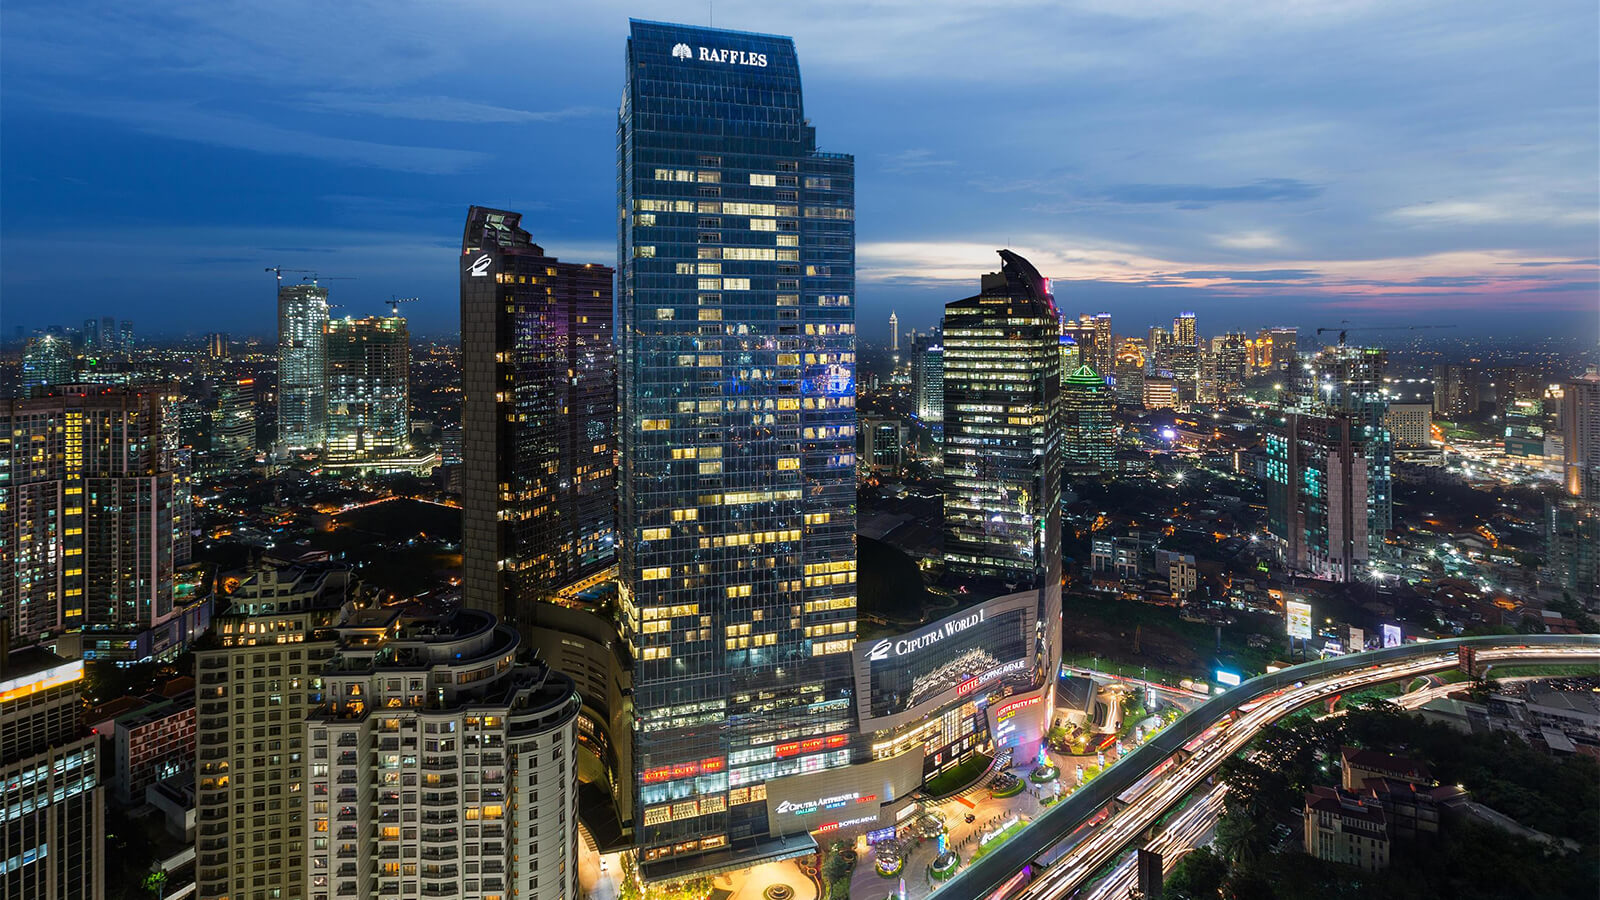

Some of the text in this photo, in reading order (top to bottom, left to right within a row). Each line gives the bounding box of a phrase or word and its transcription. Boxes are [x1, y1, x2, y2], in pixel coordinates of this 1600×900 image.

[699, 47, 767, 67] RAFFLES
[895, 629, 944, 655] CIPUTRA
[945, 614, 979, 636] WORLD
[958, 679, 979, 695] LOTTE
[1003, 660, 1025, 674] AVENUE
[1012, 700, 1028, 710] DUTY
[789, 800, 818, 811] CIPUTRA
[819, 823, 839, 832] LOTTE
